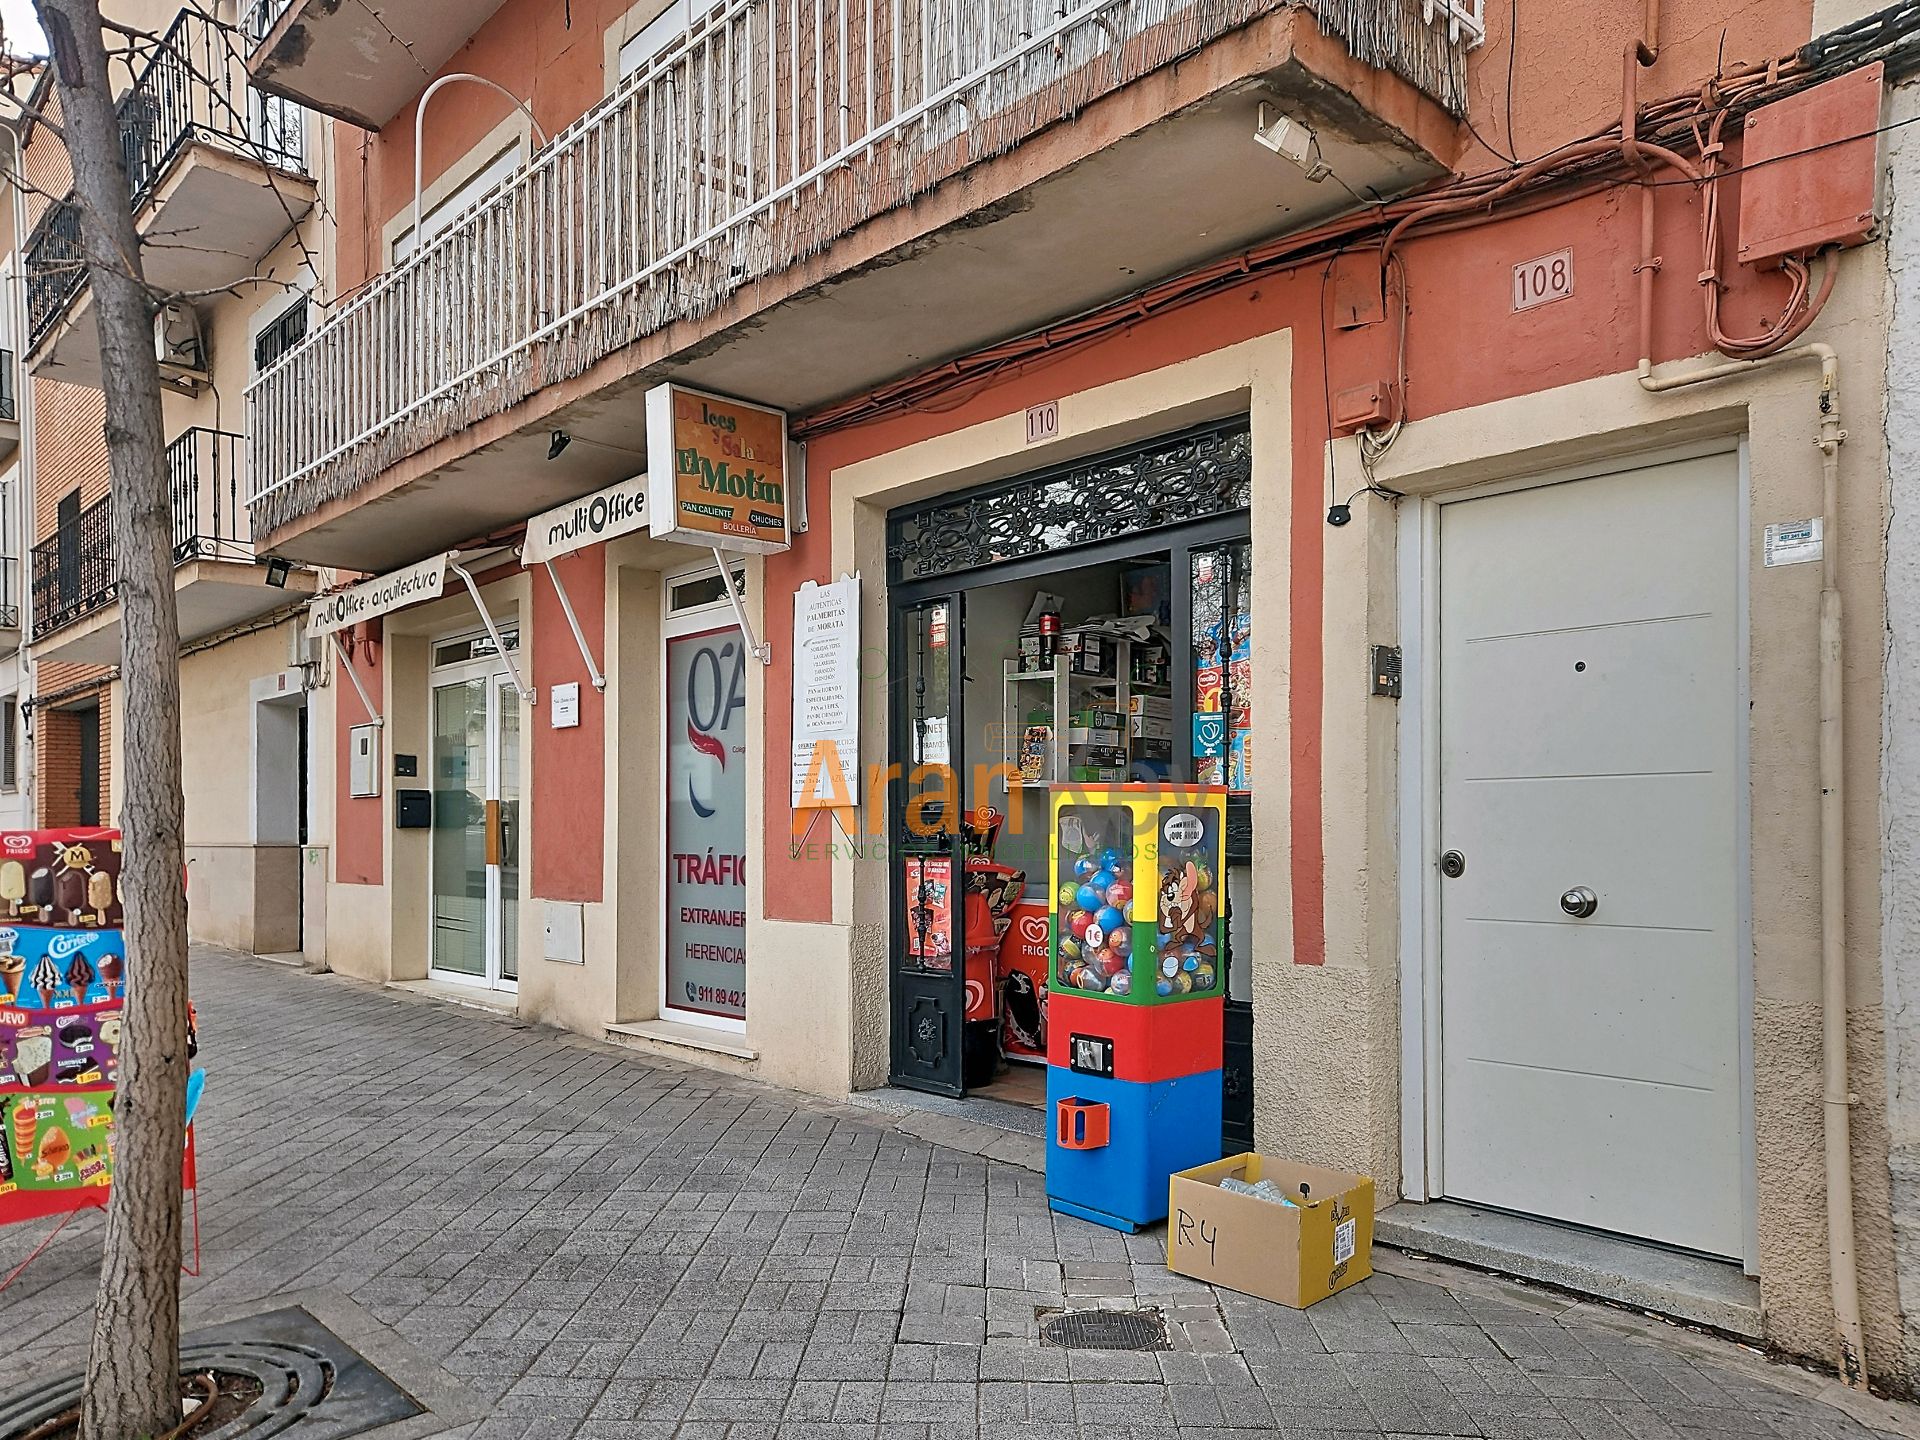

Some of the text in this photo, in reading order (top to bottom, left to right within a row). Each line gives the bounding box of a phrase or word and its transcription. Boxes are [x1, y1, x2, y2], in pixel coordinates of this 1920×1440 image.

[1518, 258, 1566, 302] 108
[1028, 407, 1055, 437] 110
[676, 447, 783, 505] El Motín
[548, 492, 645, 546] multiOffice
[681, 501, 732, 519] PAN CALIENTE
[750, 513, 783, 527] CHUCHES
[819, 590, 831, 599] LAS
[315, 594, 366, 628] multiOffice
[806, 608, 846, 622] PALMERITAS
[807, 620, 844, 633] DE MORATA
[838, 759, 850, 769] SIN
[70, 850, 85, 861] M
[1087, 929, 1101, 942] 1€
[685, 942, 746, 965] HERENCIA
[698, 985, 713, 1003] 911
[715, 988, 727, 1005] 89
[728, 990, 740, 1007] 42
